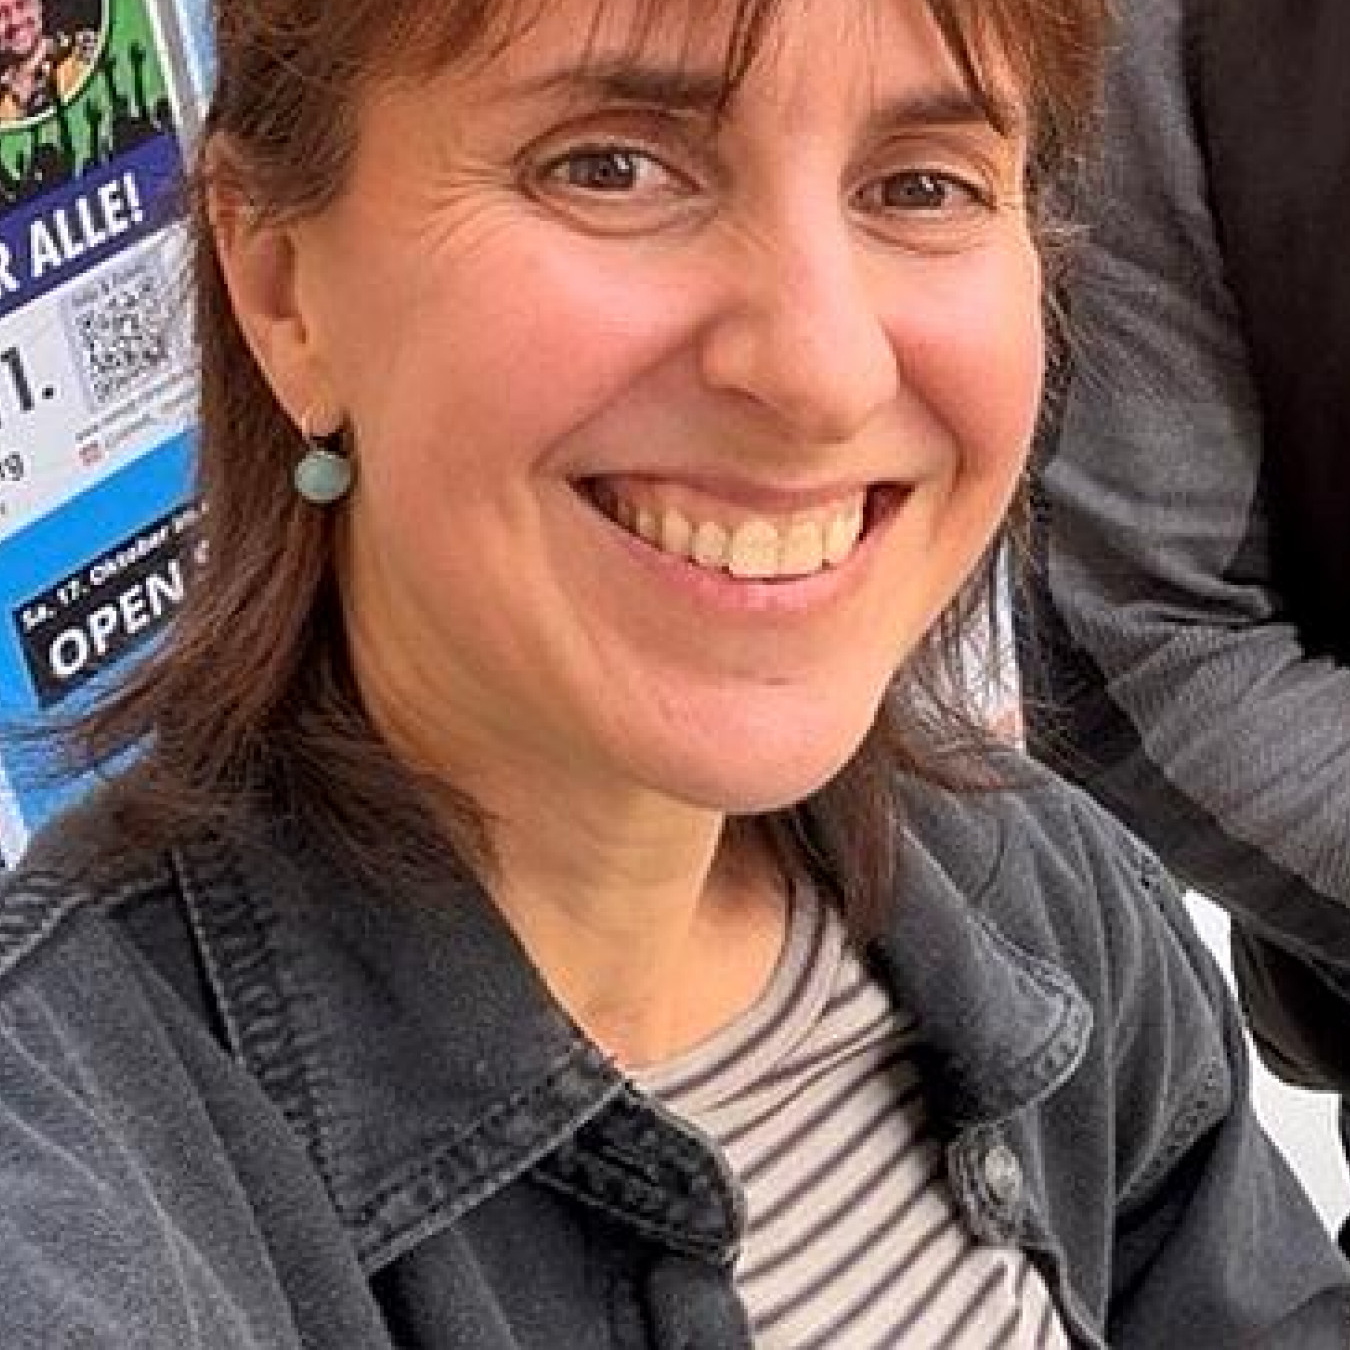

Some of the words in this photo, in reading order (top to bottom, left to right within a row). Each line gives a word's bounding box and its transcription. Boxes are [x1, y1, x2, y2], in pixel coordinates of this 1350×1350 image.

[30, 172, 145, 278] ALLE!
[48, 558, 186, 679] OPEN
[56, 579, 88, 606] 17.
[89, 525, 170, 587] Oktober
